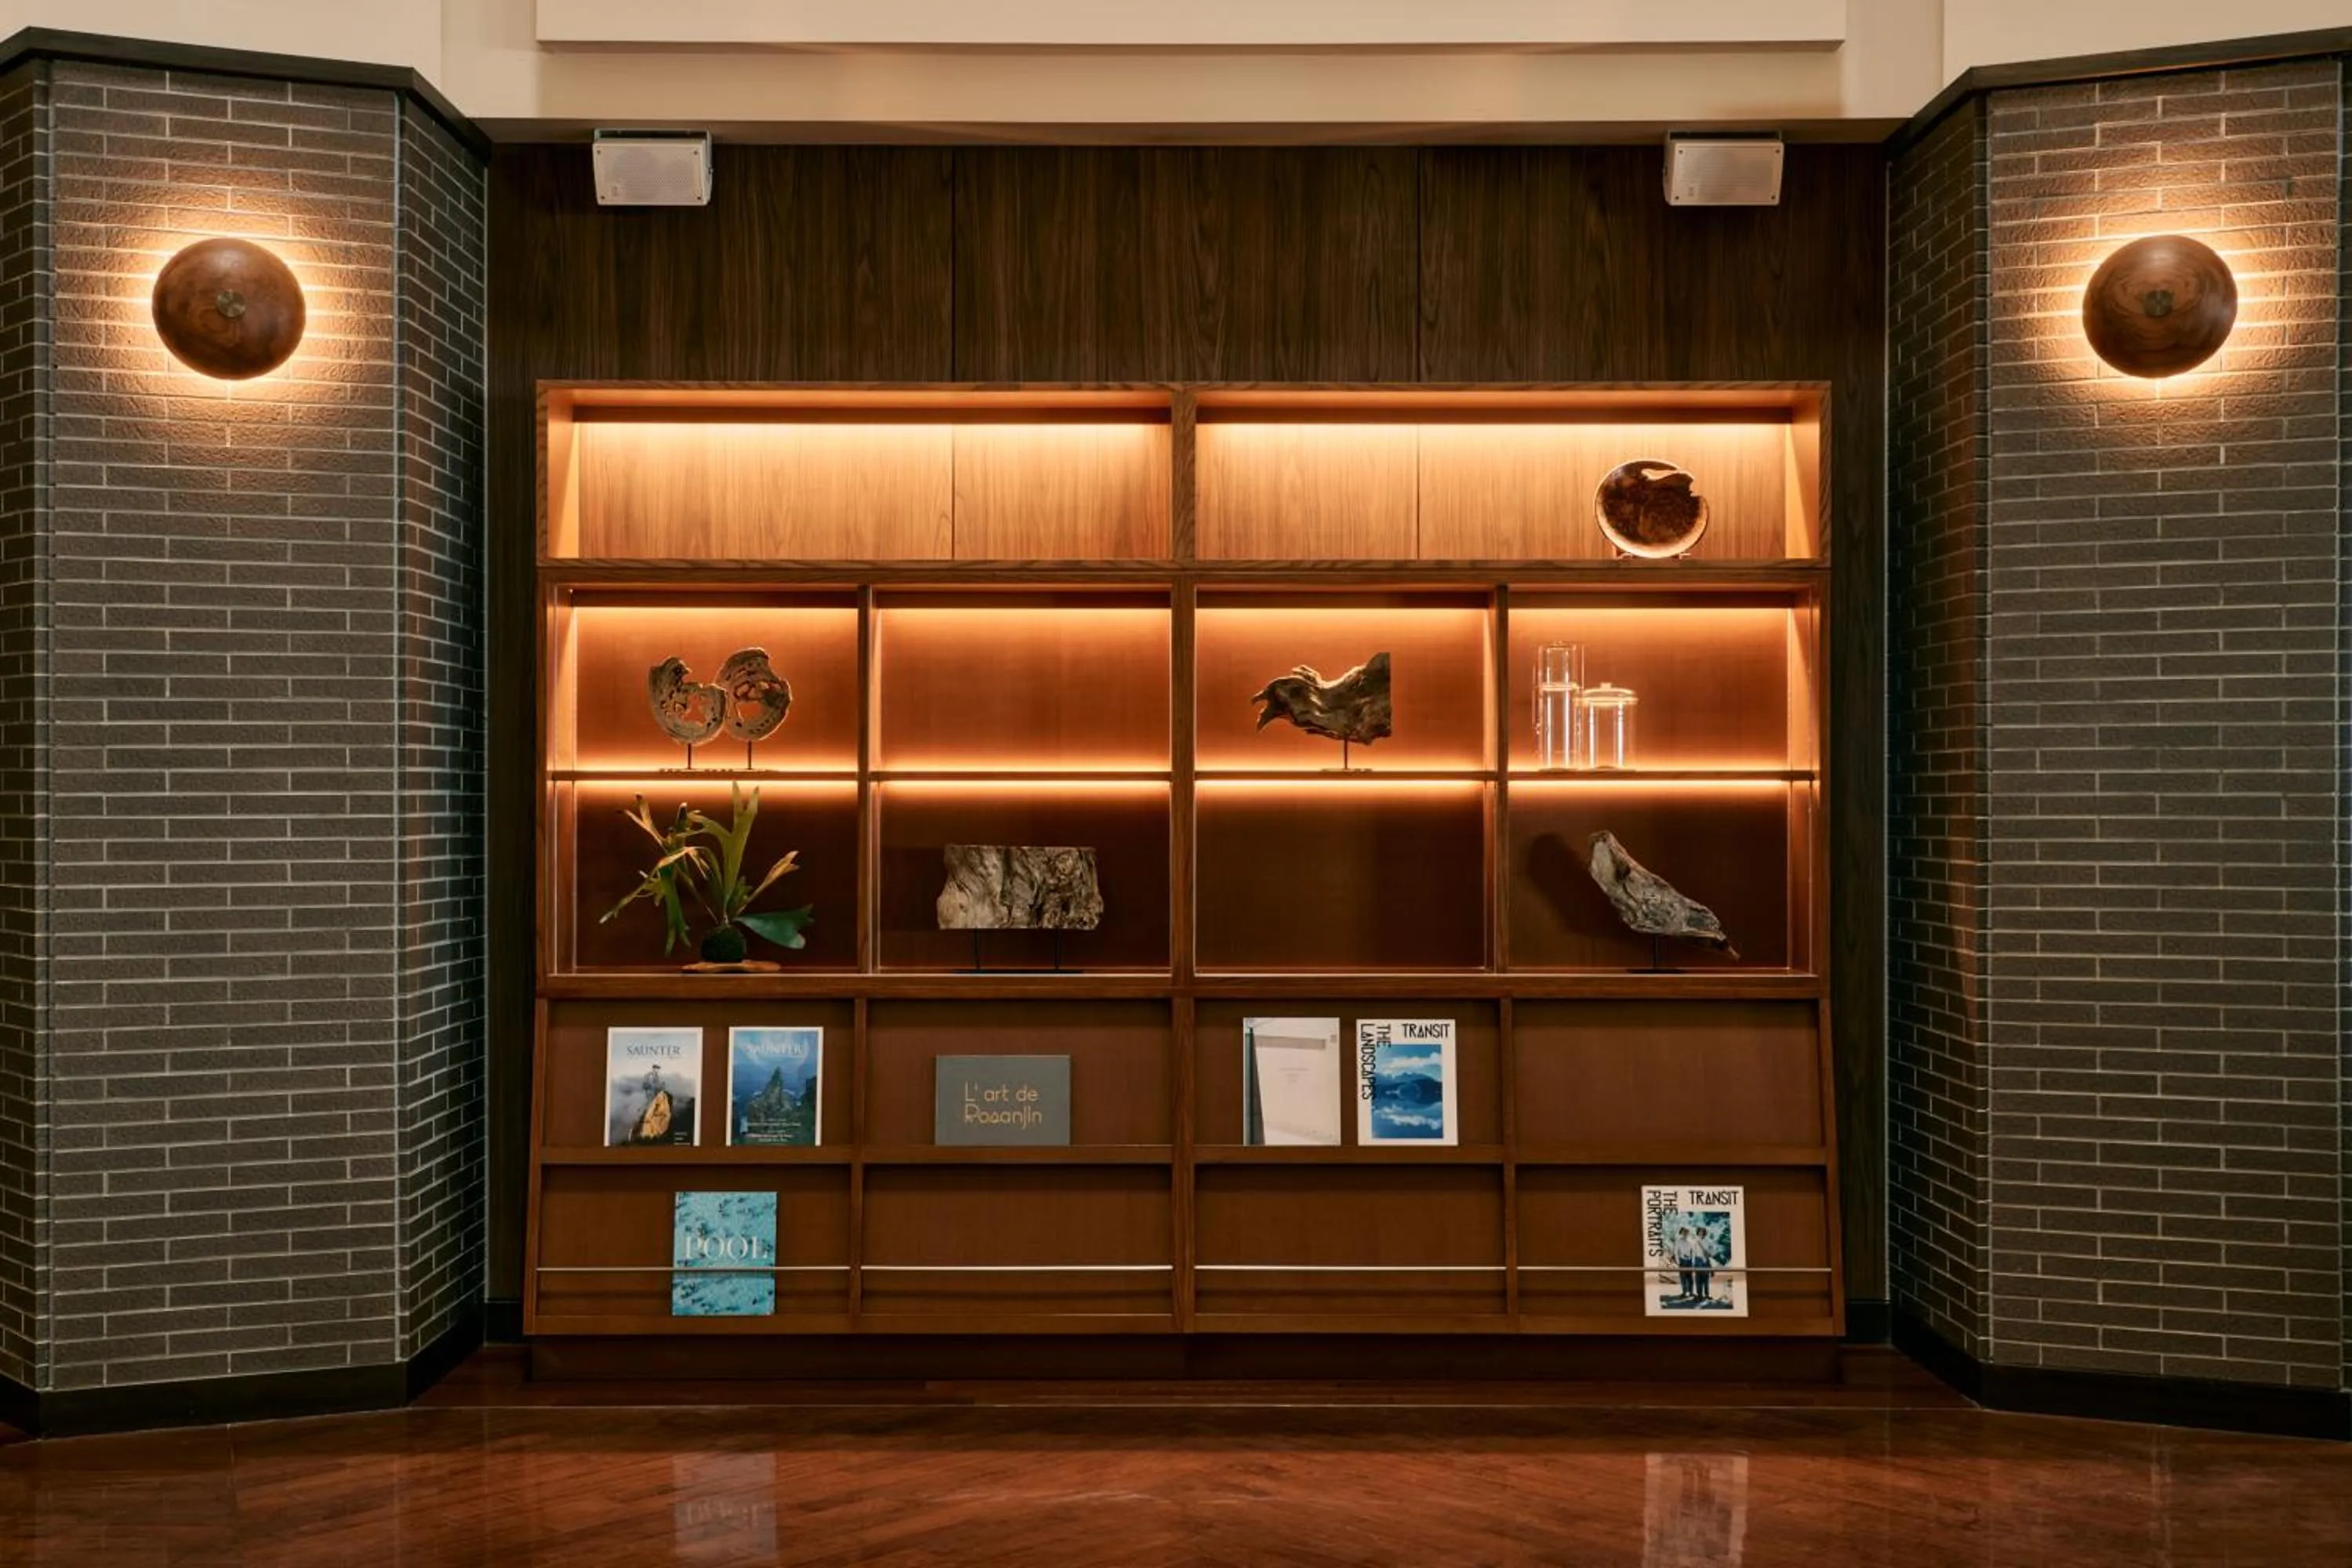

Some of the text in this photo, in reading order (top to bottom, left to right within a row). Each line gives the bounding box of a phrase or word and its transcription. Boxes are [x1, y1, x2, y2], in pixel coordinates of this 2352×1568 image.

[1377, 1024, 1391, 1047] THE
[1402, 1023, 1450, 1039] TRANSIT
[626, 1045, 681, 1056] SAUNTER
[1360, 1023, 1377, 1100] LANDSCAPES
[1015, 1083, 1039, 1102] de
[1663, 1191, 1678, 1216] THE
[1688, 1191, 1739, 1205] TRANSIT
[1647, 1189, 1664, 1257] PORTRAITS
[684, 1236, 768, 1260] POOL
